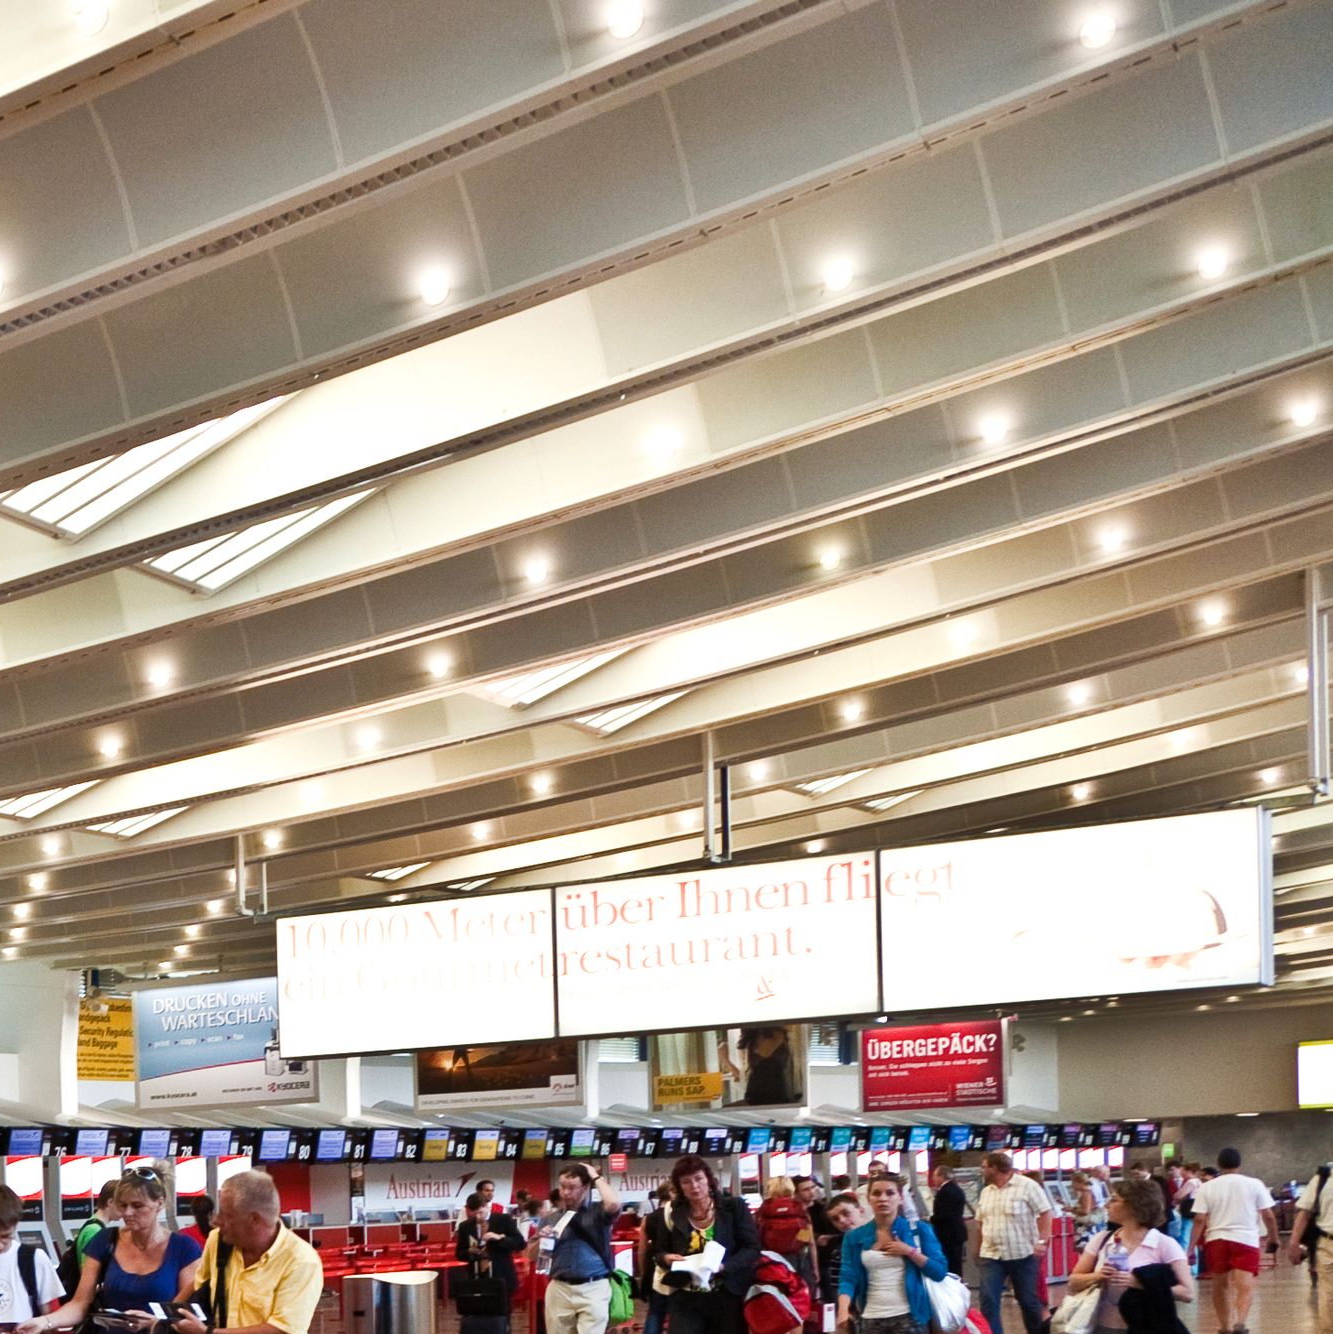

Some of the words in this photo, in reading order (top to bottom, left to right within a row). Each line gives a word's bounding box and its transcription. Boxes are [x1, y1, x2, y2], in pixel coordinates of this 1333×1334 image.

[422, 904, 546, 943] Meter
[560, 888, 666, 930] über
[674, 878, 811, 919] Ihnen
[153, 991, 228, 1015] DRUCKEN
[232, 991, 267, 1006] OHNE
[161, 1005, 279, 1032] WARTESCHLAN
[867, 1032, 997, 1061] ÜBERGEPÄCK?
[658, 1075, 702, 1087] PALMERS
[298, 1145, 311, 1160] 80
[354, 1144, 365, 1158] 81
[405, 1144, 417, 1158] 82
[456, 1143, 467, 1157] 83
[506, 1143, 517, 1157] 84
[386, 1173, 451, 1200] Austrian
